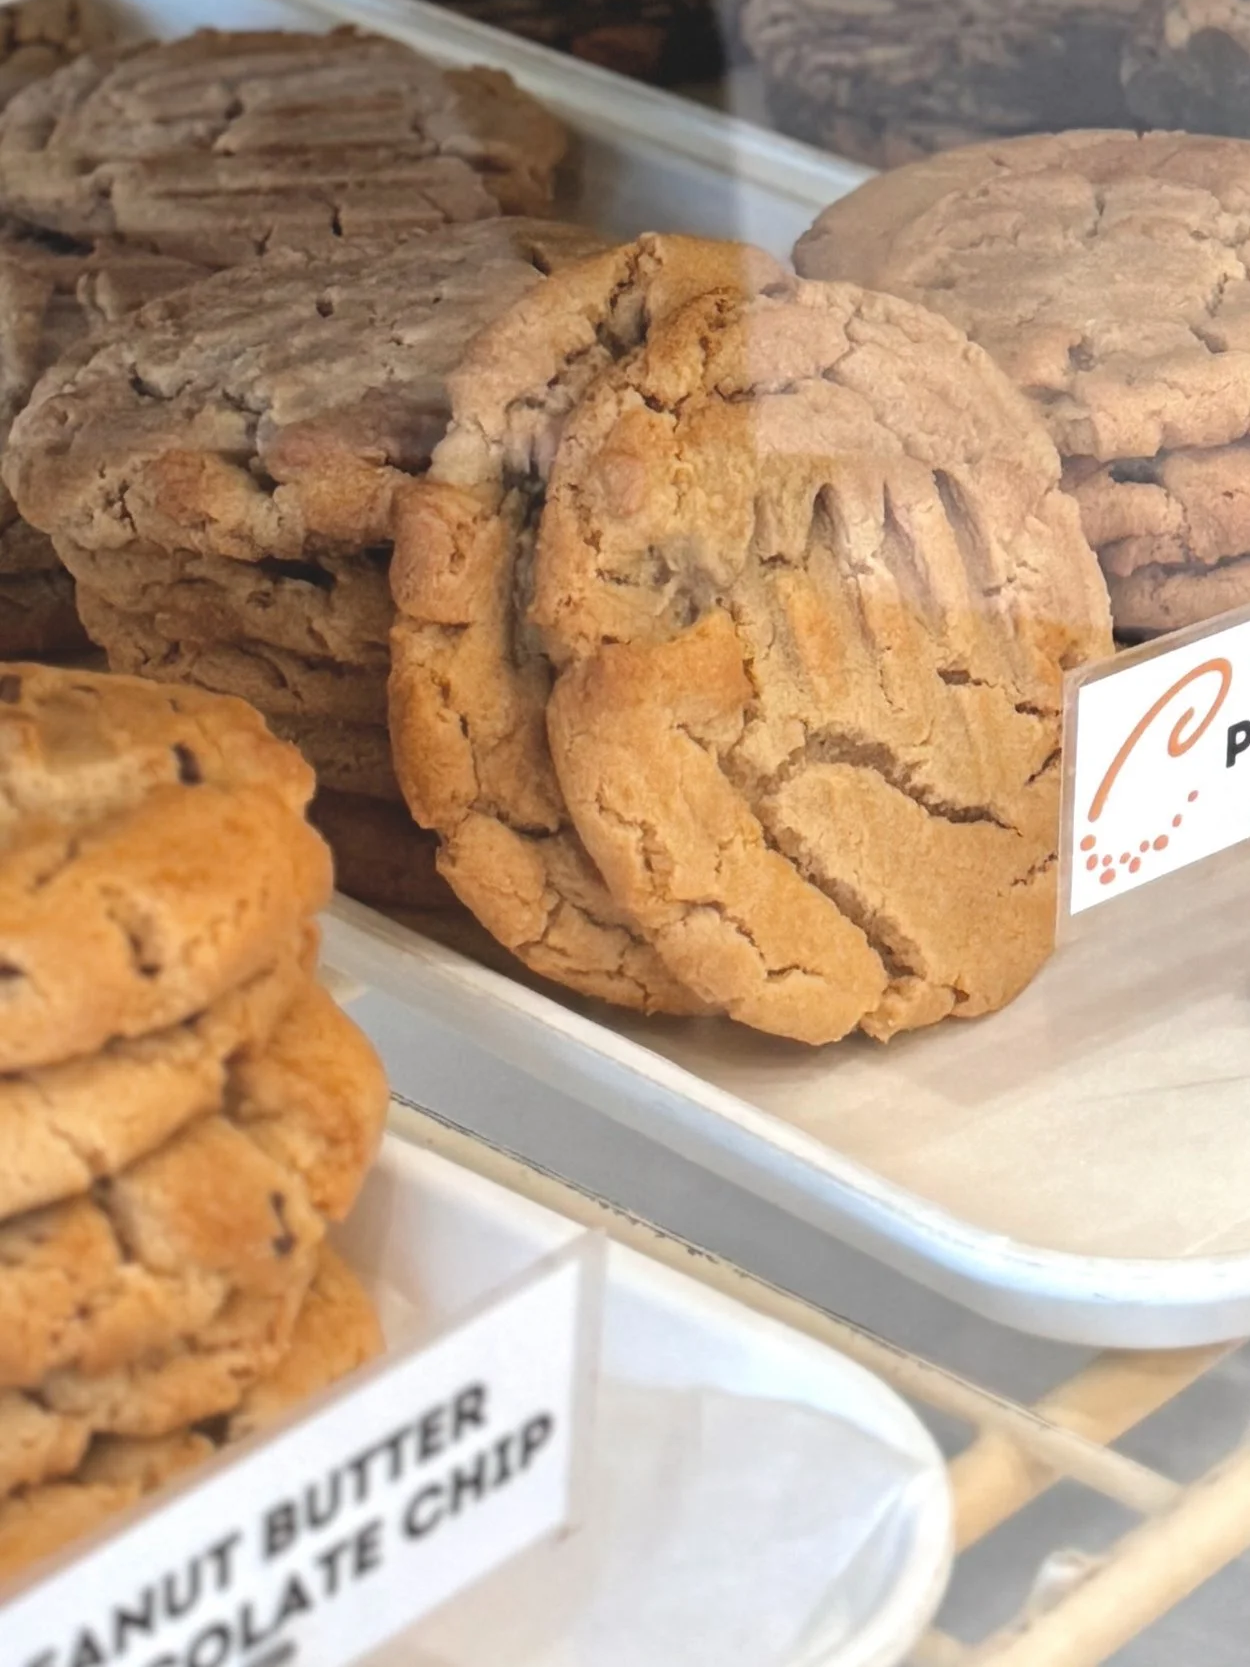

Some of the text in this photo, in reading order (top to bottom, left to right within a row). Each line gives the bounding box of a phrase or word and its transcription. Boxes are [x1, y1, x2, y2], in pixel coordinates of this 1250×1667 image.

[143, 1410, 554, 1667] OLATE CHIP
[262, 1380, 489, 1564] BUTTER
